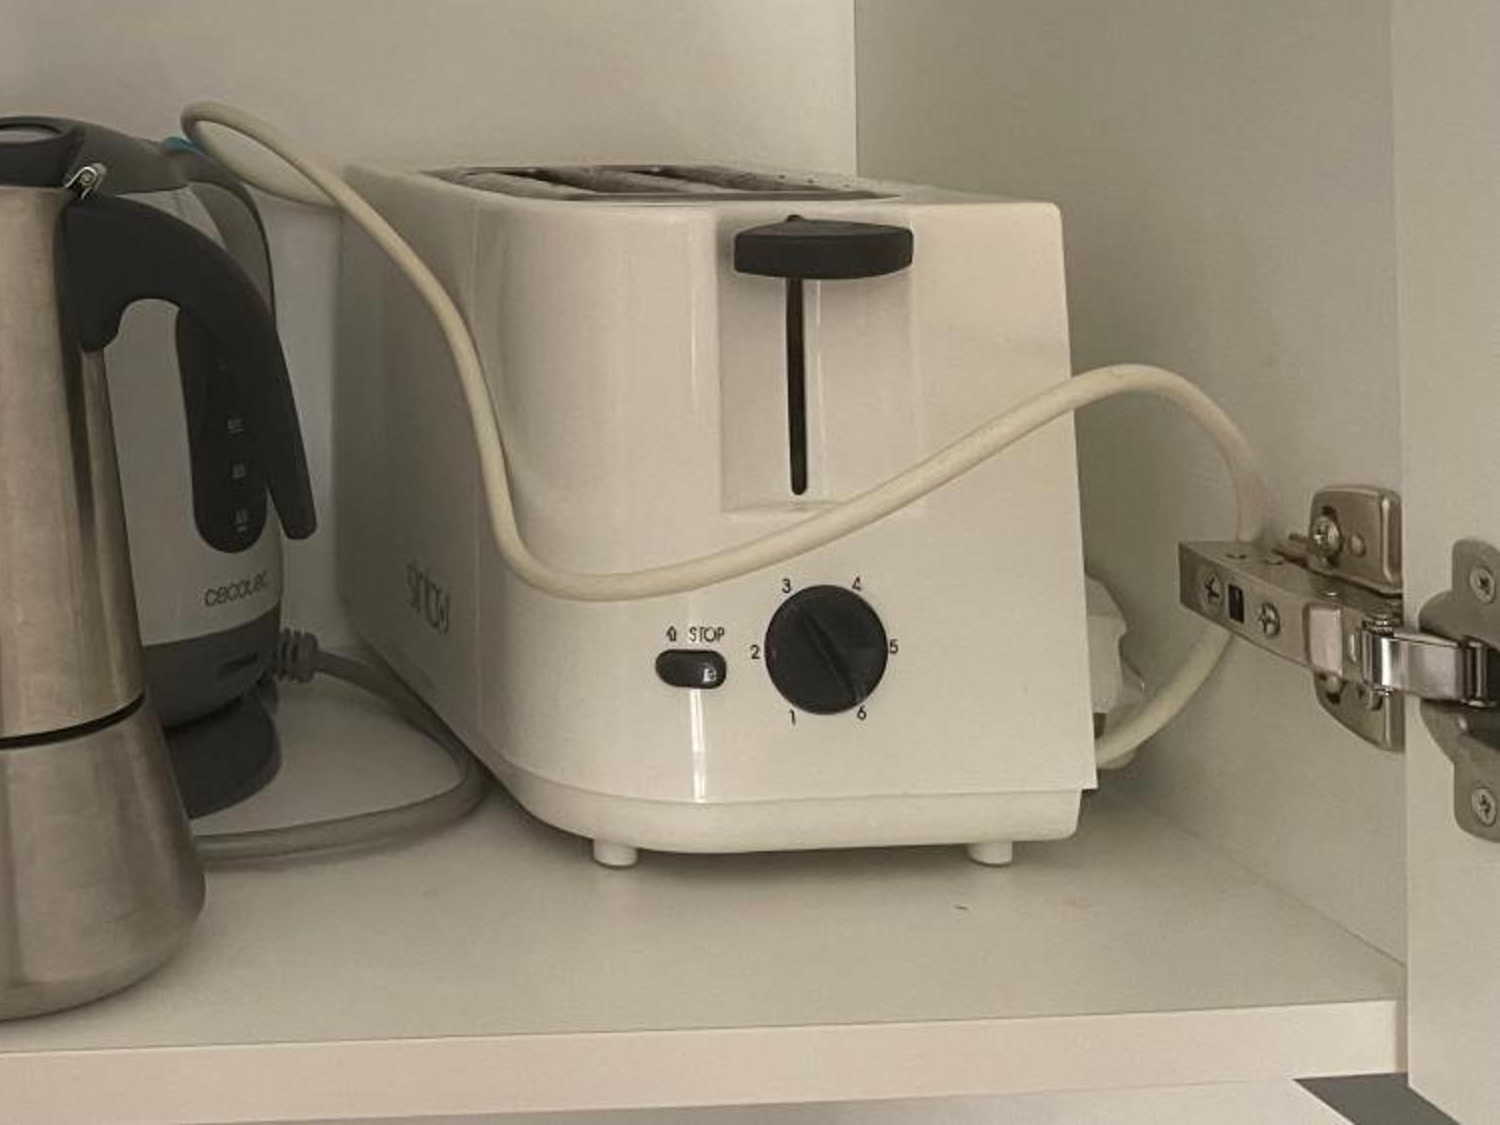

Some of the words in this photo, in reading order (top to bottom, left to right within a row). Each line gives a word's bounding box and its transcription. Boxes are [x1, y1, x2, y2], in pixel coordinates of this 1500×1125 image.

[781, 578, 792, 593] 3
[852, 577, 862, 591] 4
[688, 626, 725, 643] STOP
[750, 645, 760, 660] 2
[888, 639, 898, 654] 5
[789, 710, 796, 725] 1
[856, 705, 867, 721] 6
